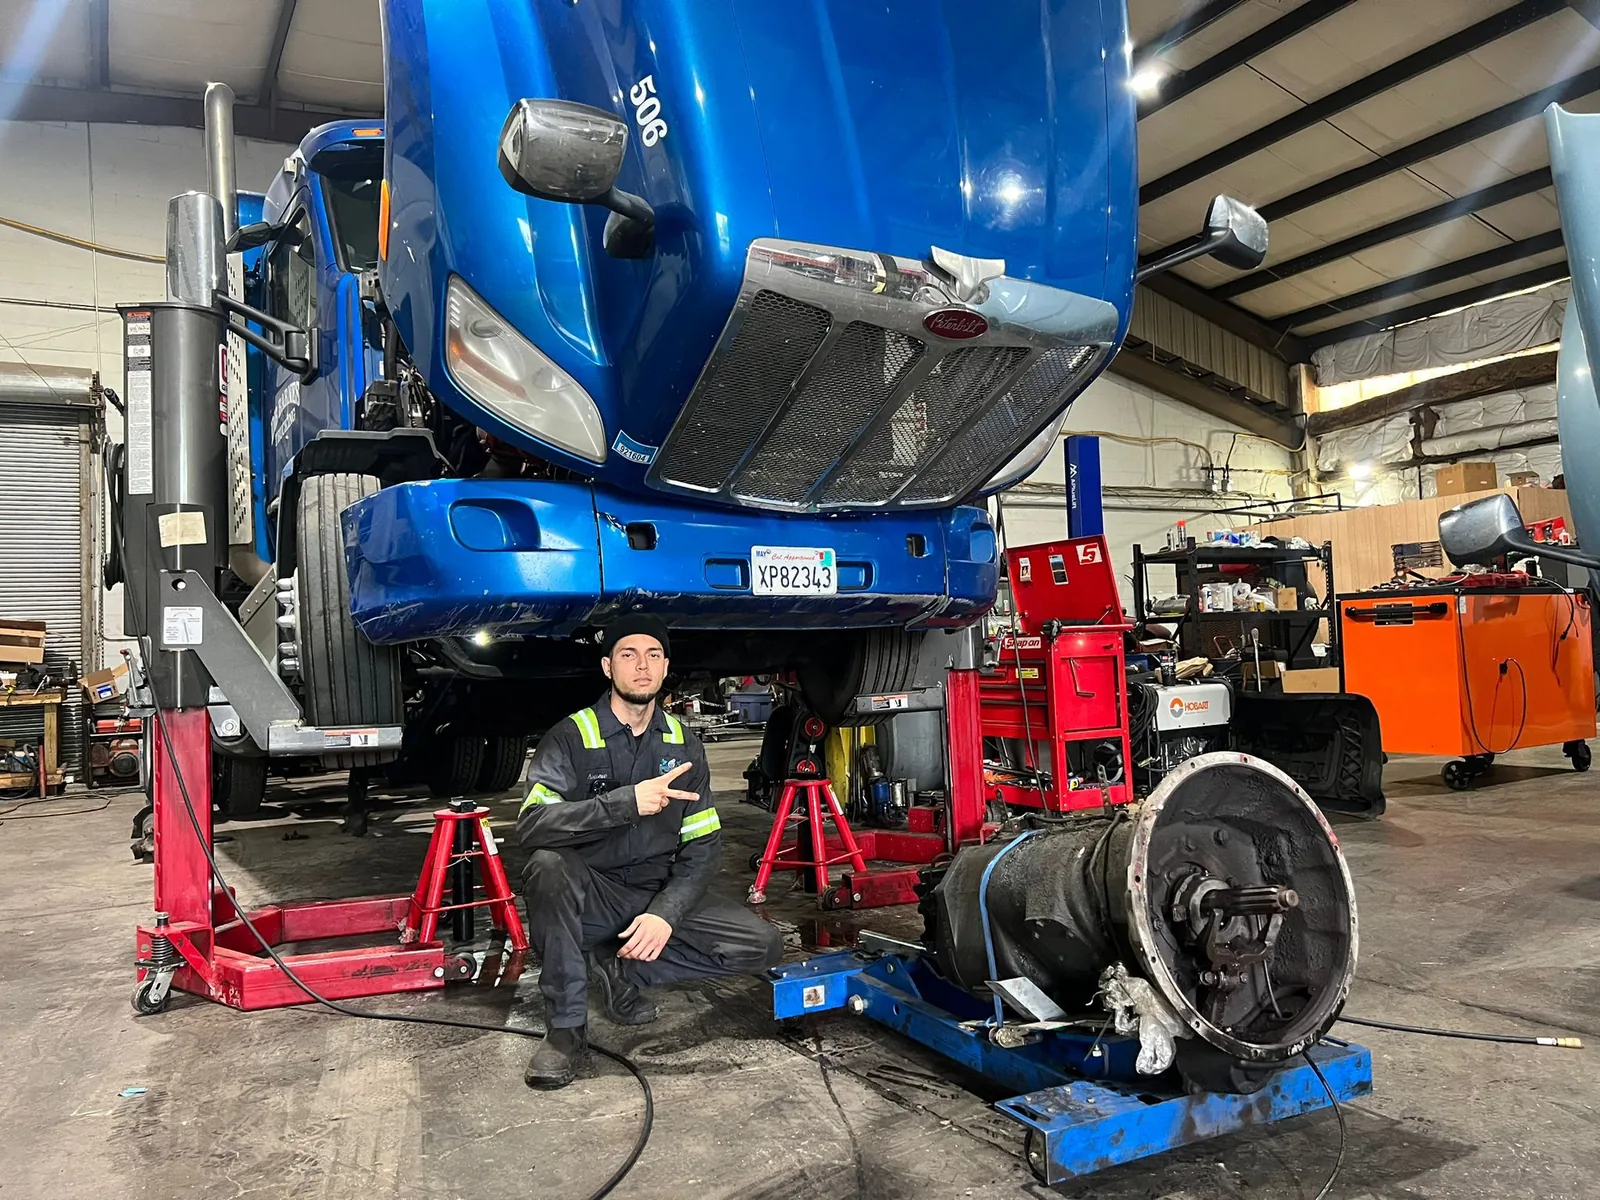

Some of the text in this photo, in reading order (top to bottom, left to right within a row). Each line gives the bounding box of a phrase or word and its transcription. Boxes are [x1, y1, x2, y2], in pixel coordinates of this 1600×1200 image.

[630, 74, 668, 147] 506
[930, 313, 984, 333] Peterbilt
[758, 565, 832, 588] XP82343
[1184, 701, 1209, 711] HOBART
